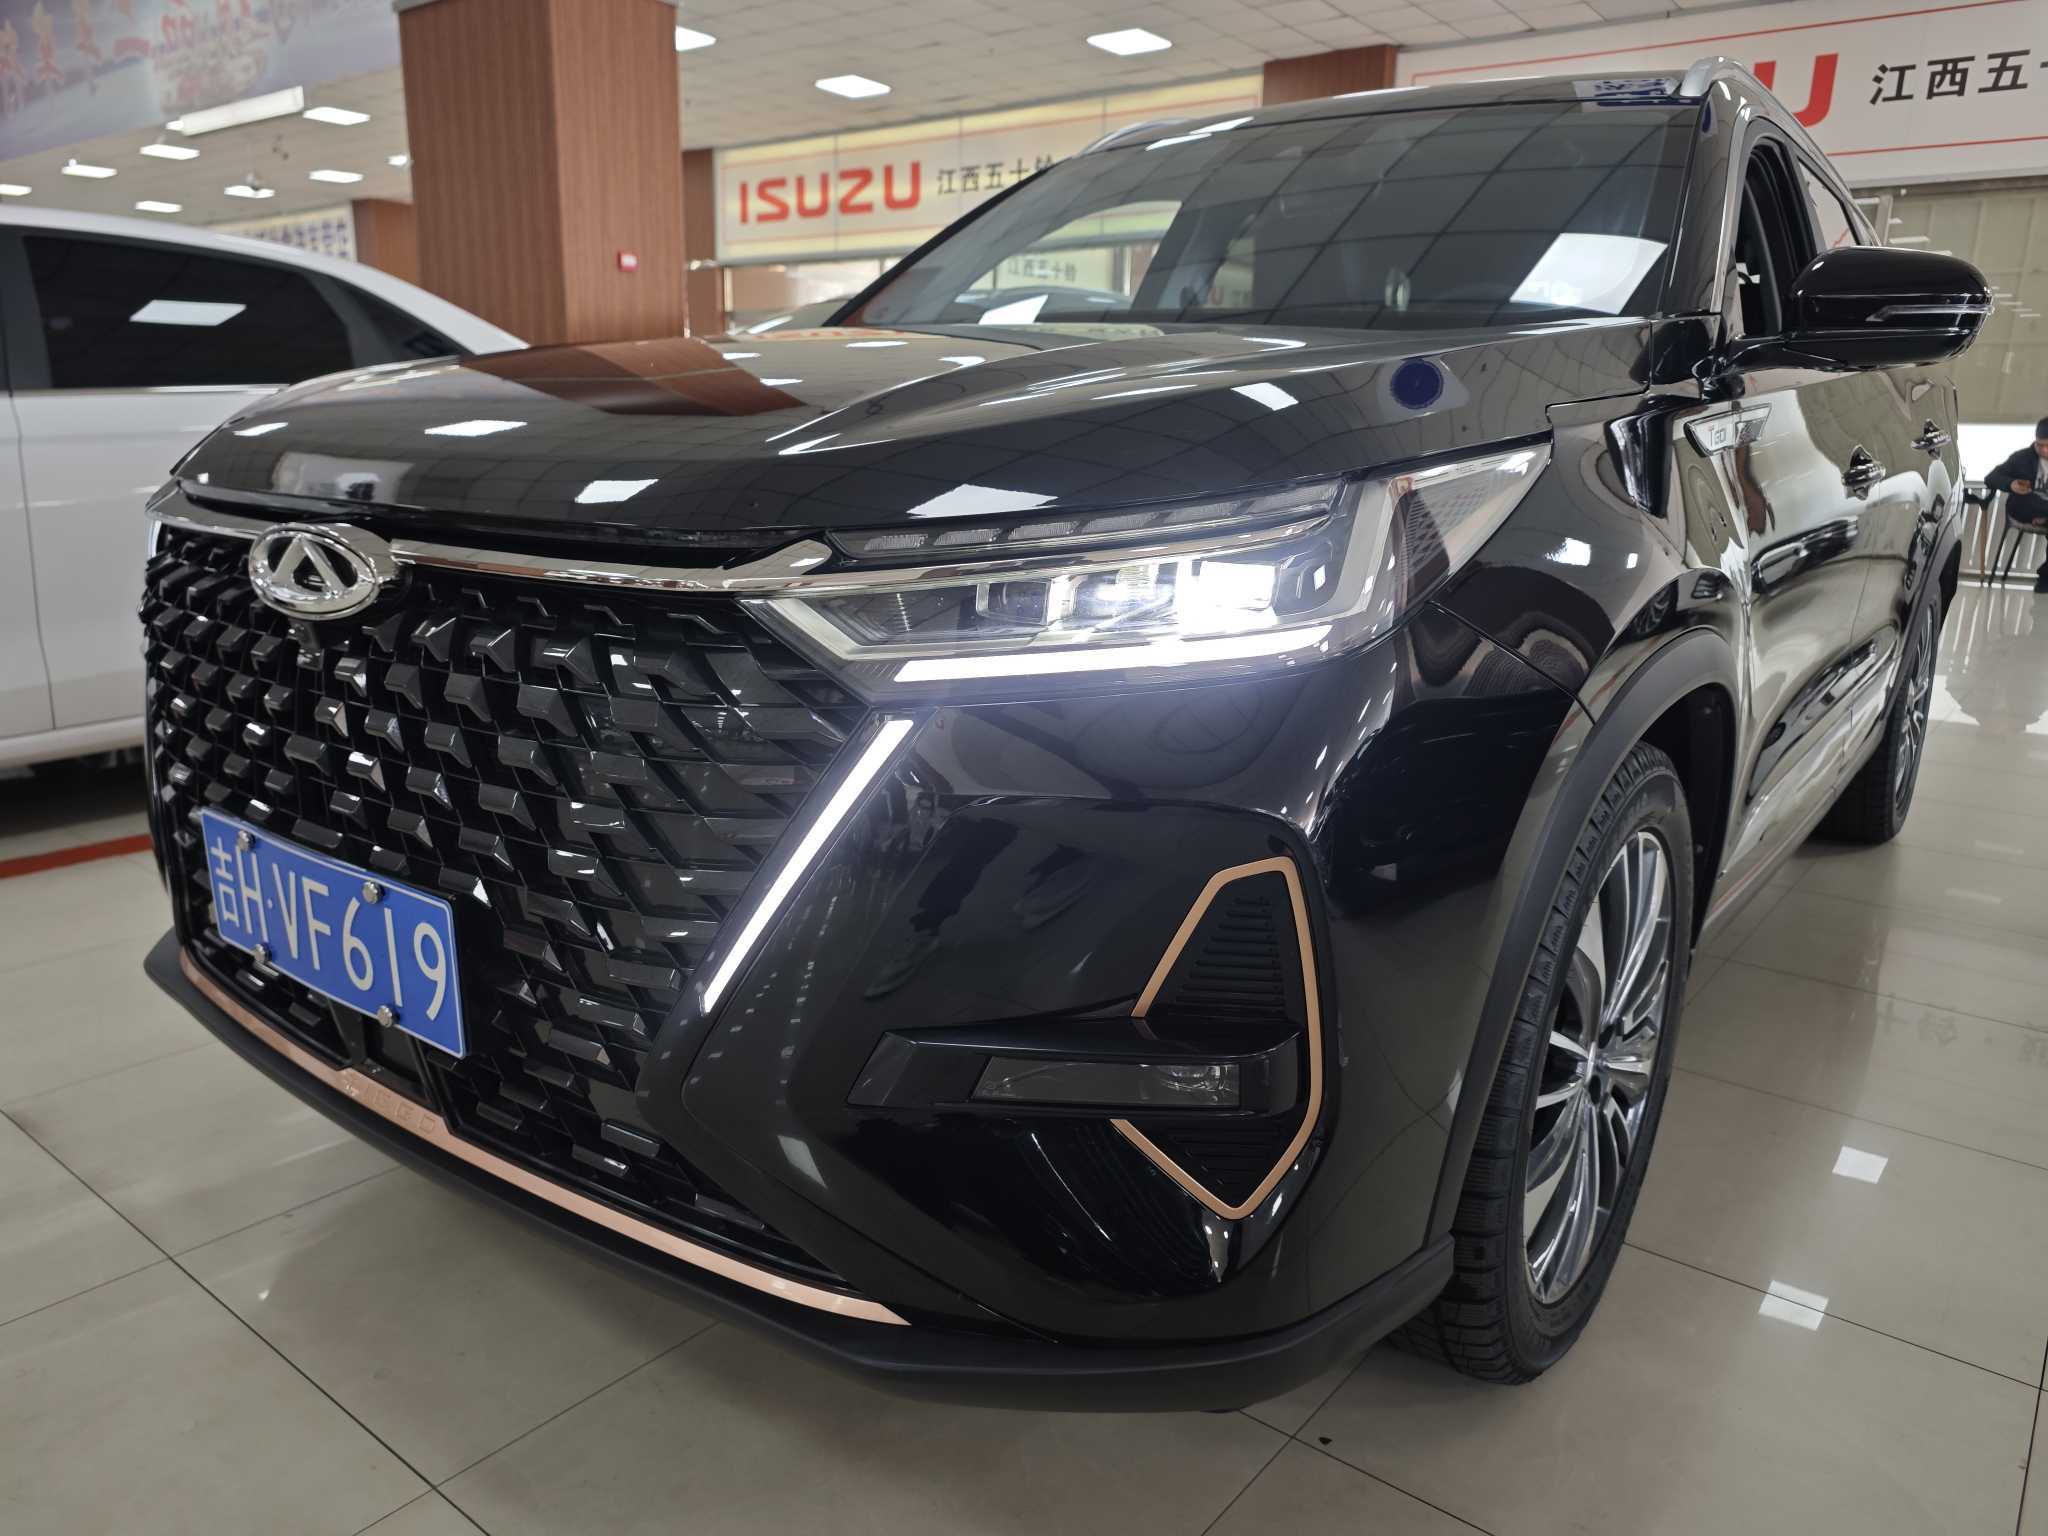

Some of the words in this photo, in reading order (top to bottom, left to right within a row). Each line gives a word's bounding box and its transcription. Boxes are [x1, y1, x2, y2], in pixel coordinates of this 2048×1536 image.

[1869, 49, 2048, 105] 江西五
[739, 160, 921, 225] ISUZU
